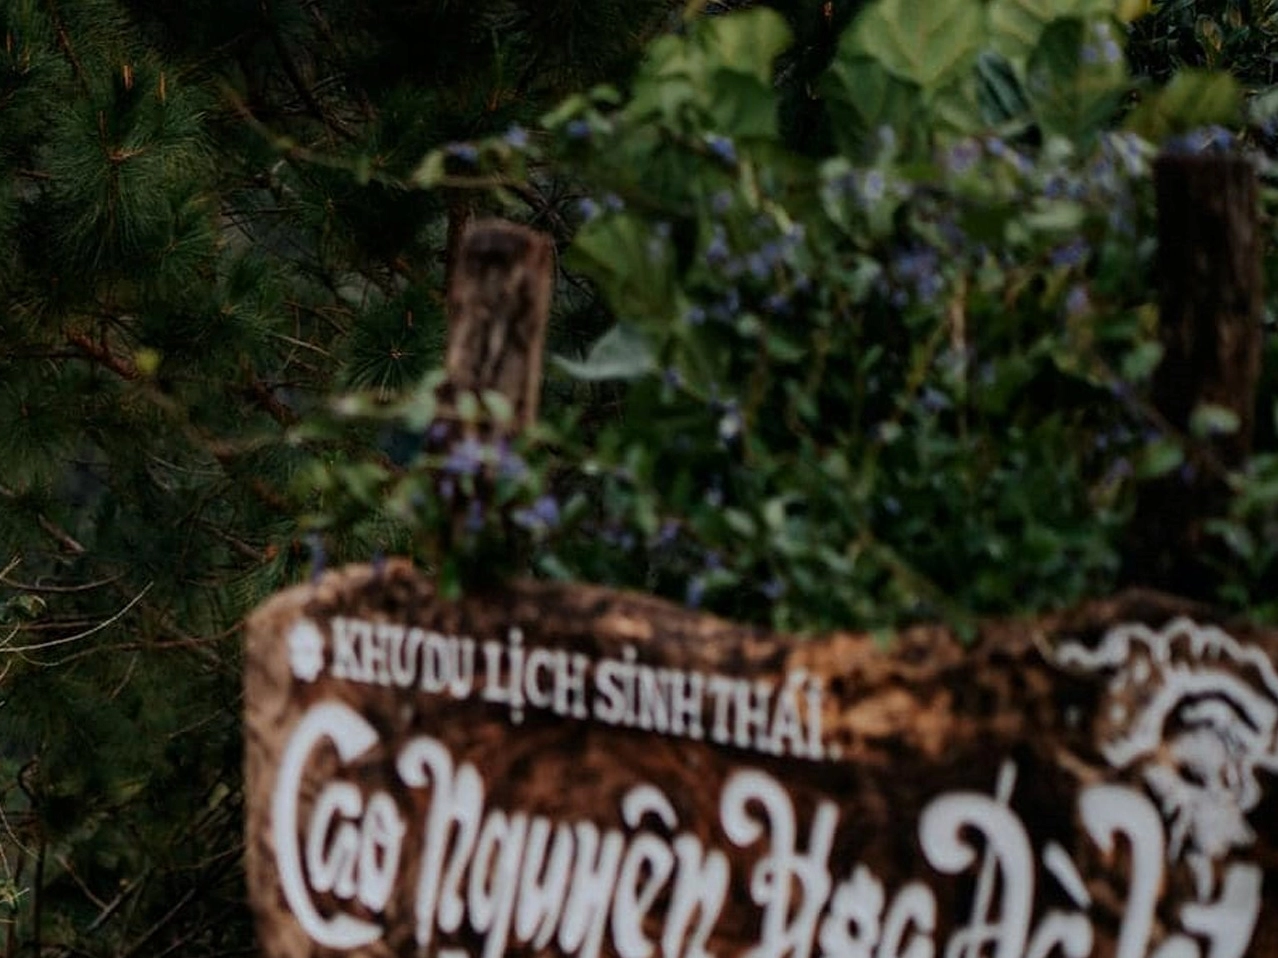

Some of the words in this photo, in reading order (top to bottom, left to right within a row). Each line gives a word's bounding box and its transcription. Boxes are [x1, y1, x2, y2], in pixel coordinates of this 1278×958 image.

[330, 615, 421, 688] KHU
[421, 631, 475, 699] DU
[270, 700, 406, 949] Cao
